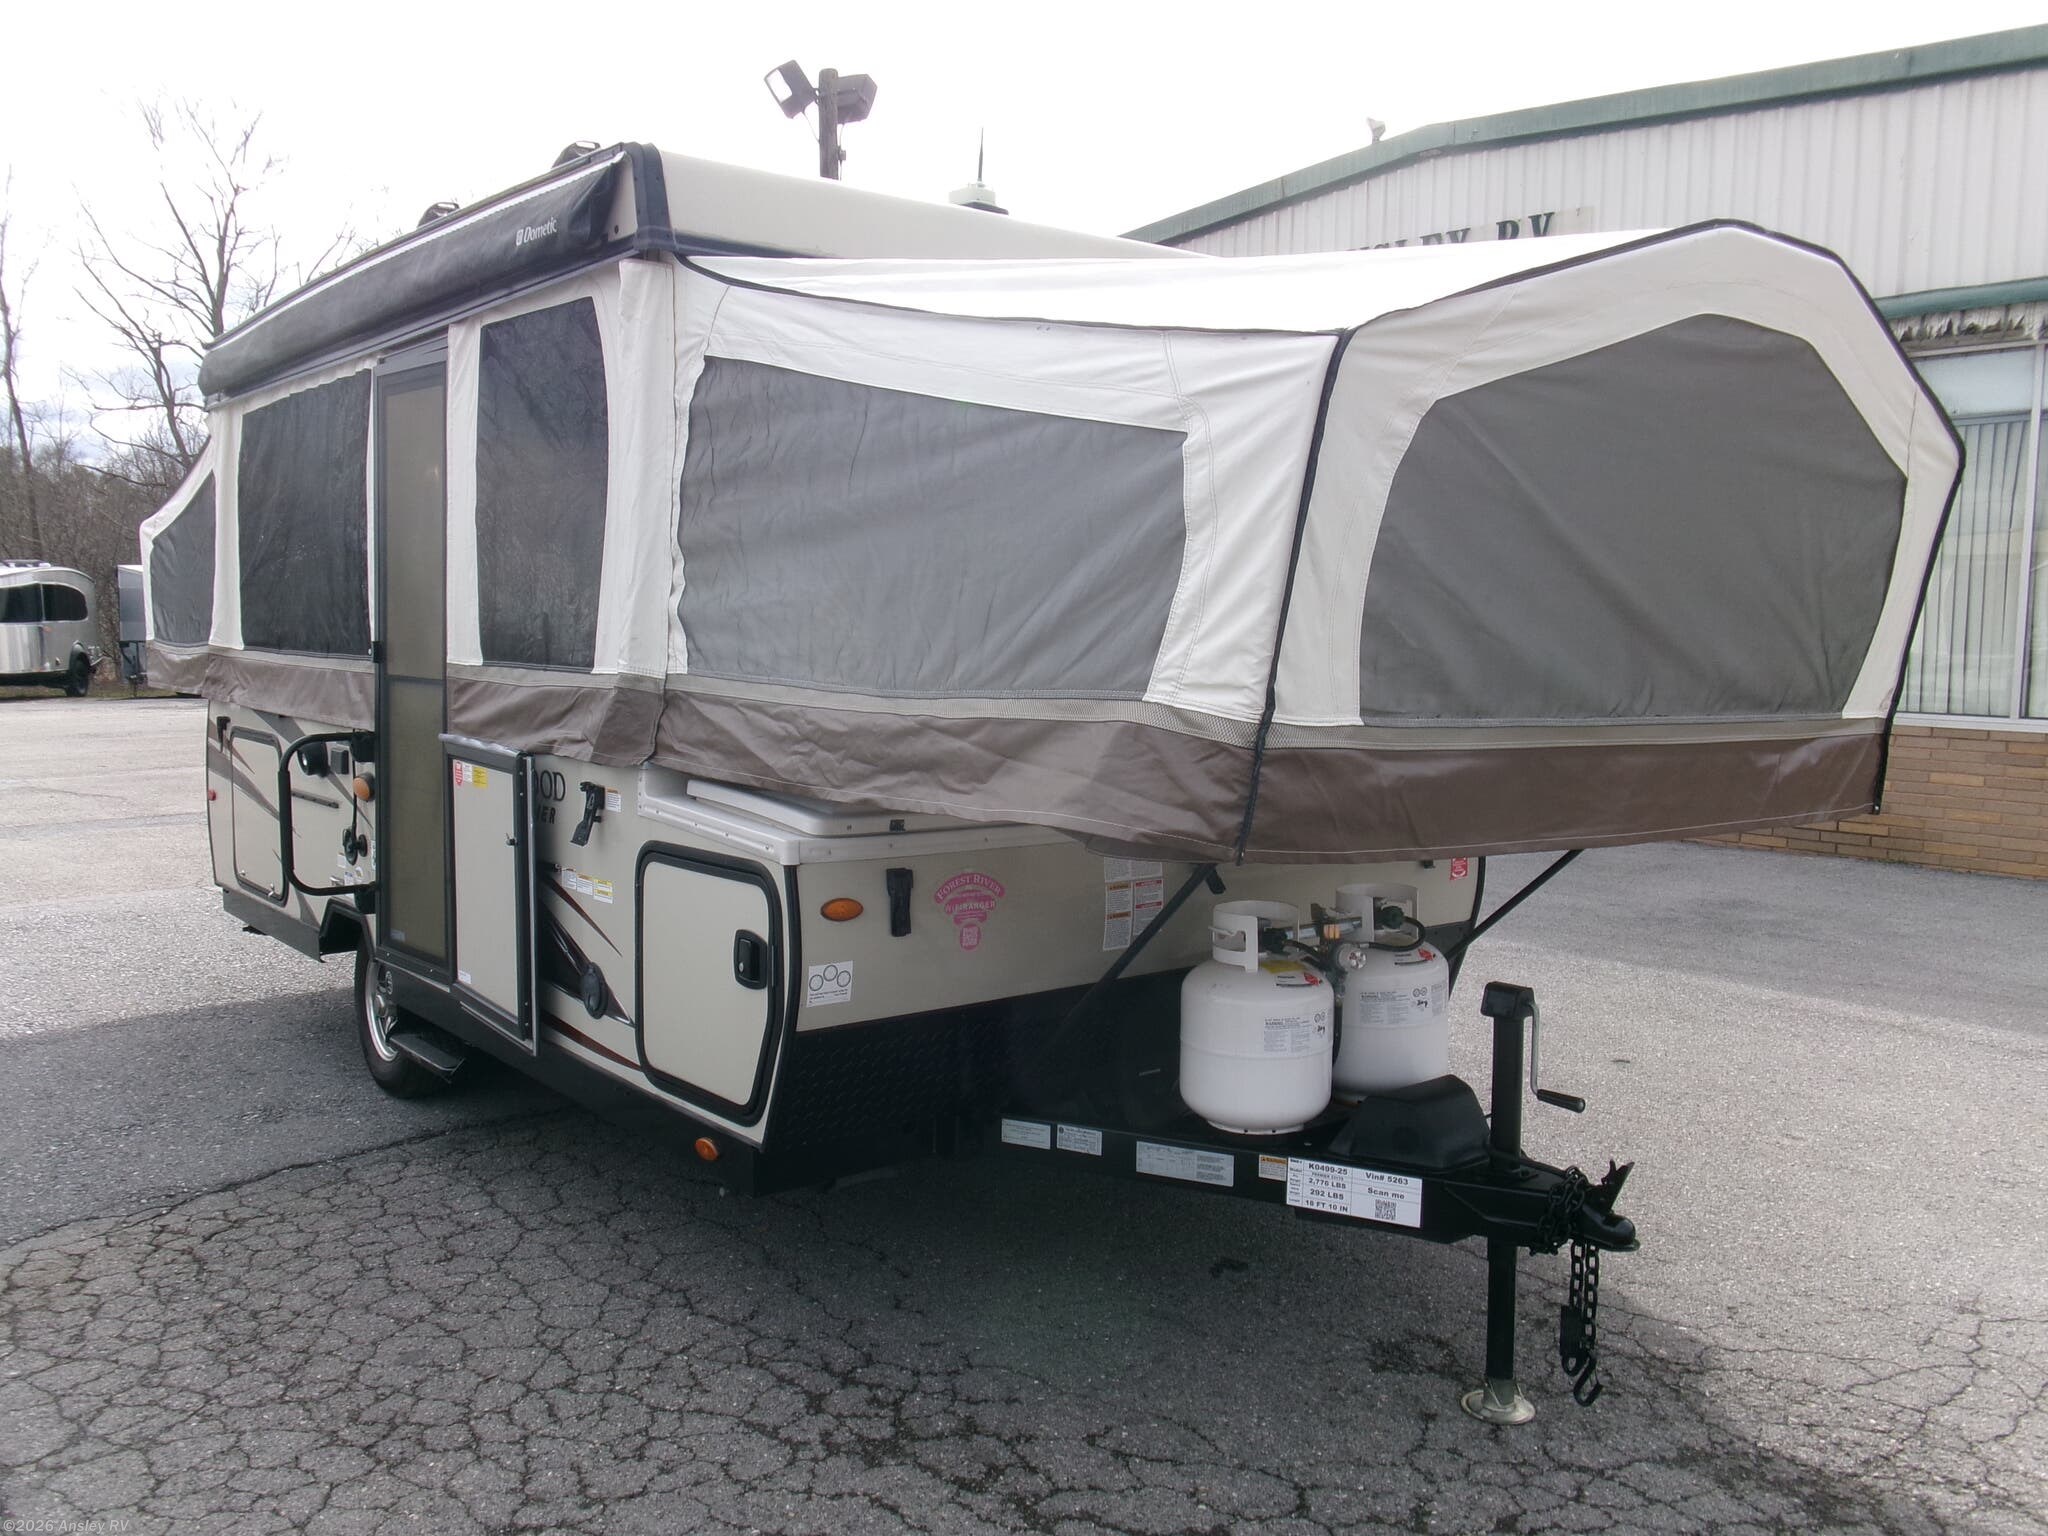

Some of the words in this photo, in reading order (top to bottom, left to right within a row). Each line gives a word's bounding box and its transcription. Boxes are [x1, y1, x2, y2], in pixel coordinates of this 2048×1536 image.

[523, 216, 558, 244] Dometic
[937, 876, 972, 900] FOREST
[973, 873, 1002, 896] RIVER
[1331, 1181, 1347, 1190] LBS
[1327, 1191, 1344, 1201] LBS
[1367, 1186, 1390, 1198] Scan
[1391, 1192, 1405, 1200] me
[1316, 1201, 1327, 1209] FT
[1339, 1205, 1349, 1213] IN
